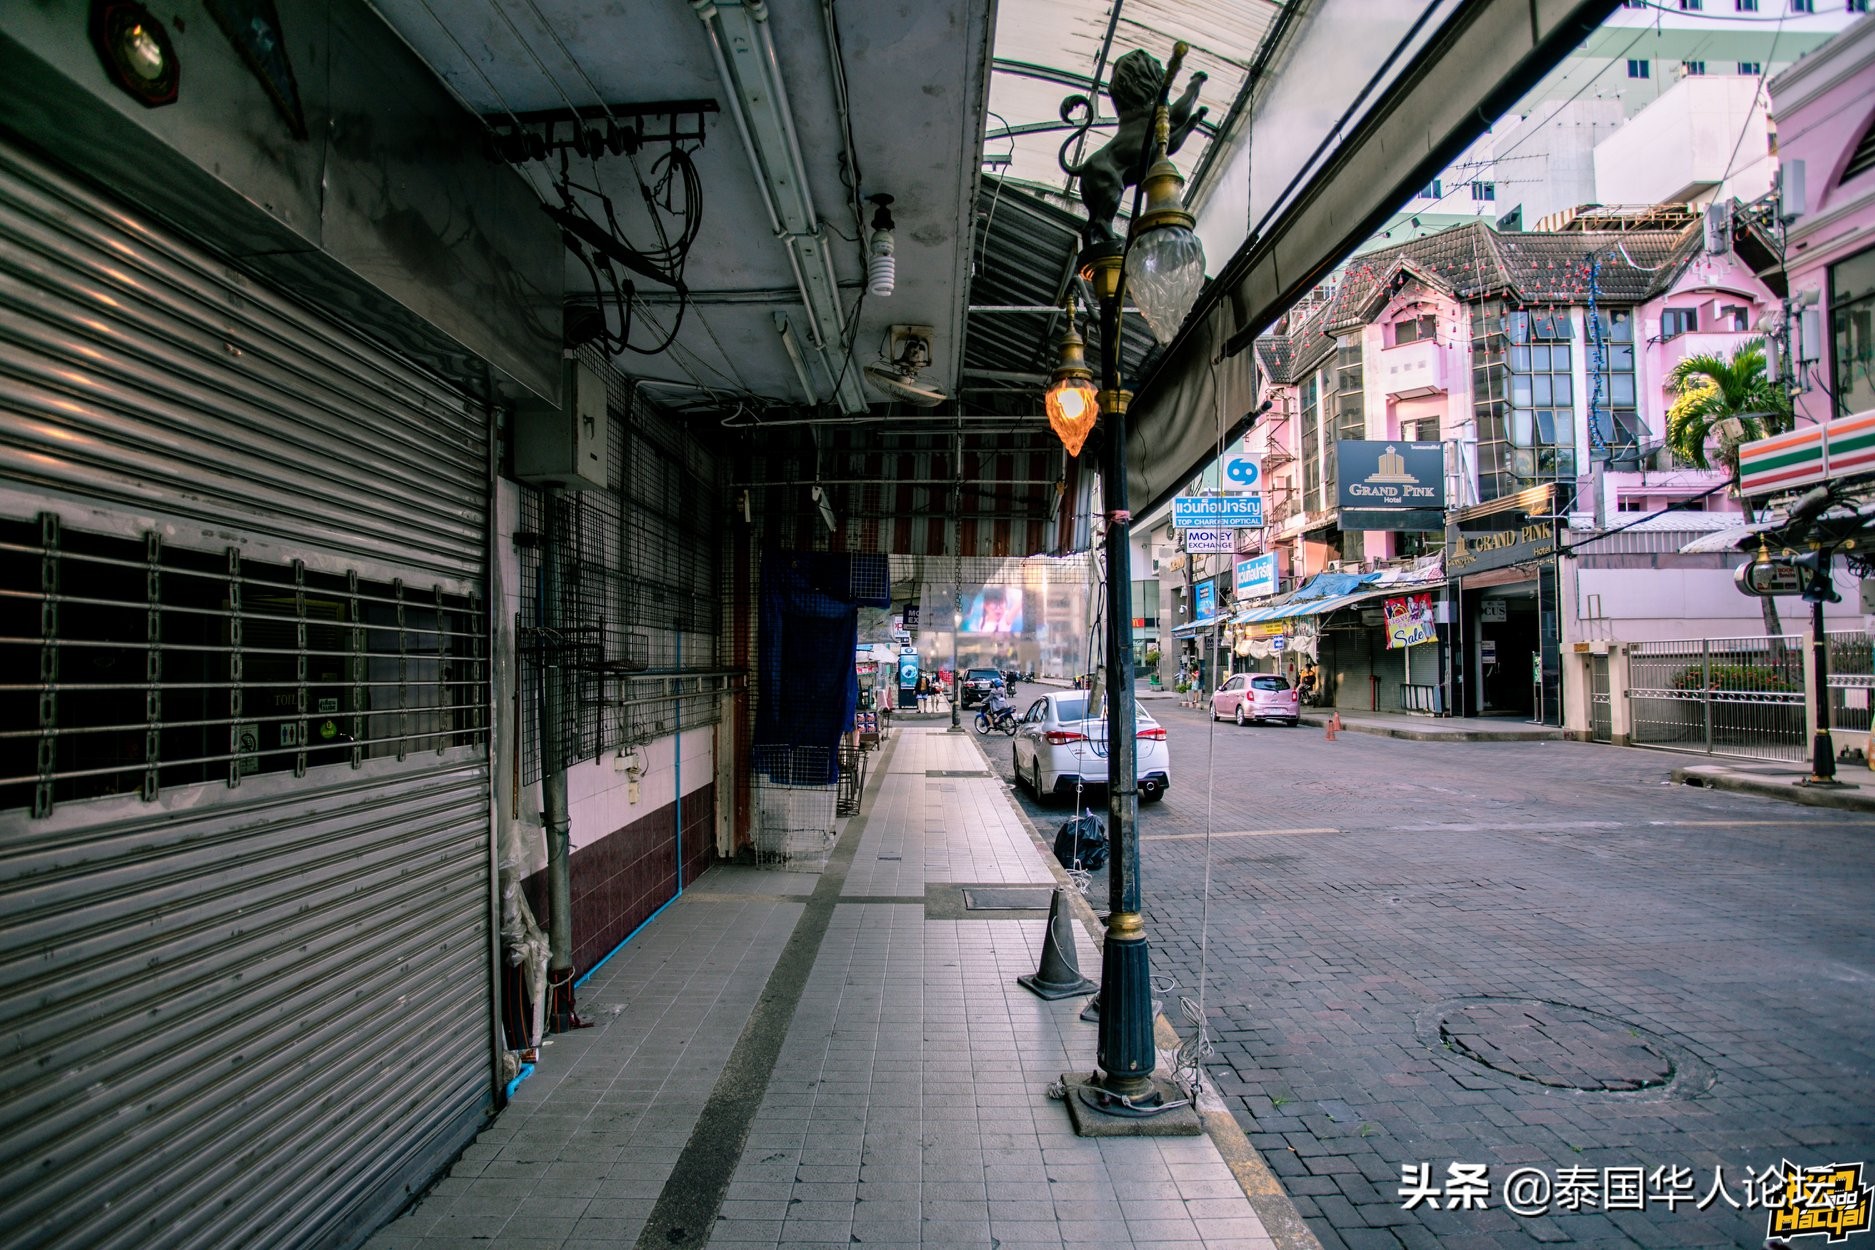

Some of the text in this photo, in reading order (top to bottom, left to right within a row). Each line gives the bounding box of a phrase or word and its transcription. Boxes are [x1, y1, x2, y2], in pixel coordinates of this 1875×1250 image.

[1176, 498, 1260, 515] แว่นท็อปเจริญ
[1178, 518, 1192, 526] TOP
[1229, 517, 1260, 525] OPTICAL
[1188, 532, 1232, 540] MONEY
[1475, 521, 1552, 553] GRAND PINK
[1533, 545, 1552, 557] Hotel
[1392, 627, 1424, 648] Sale
